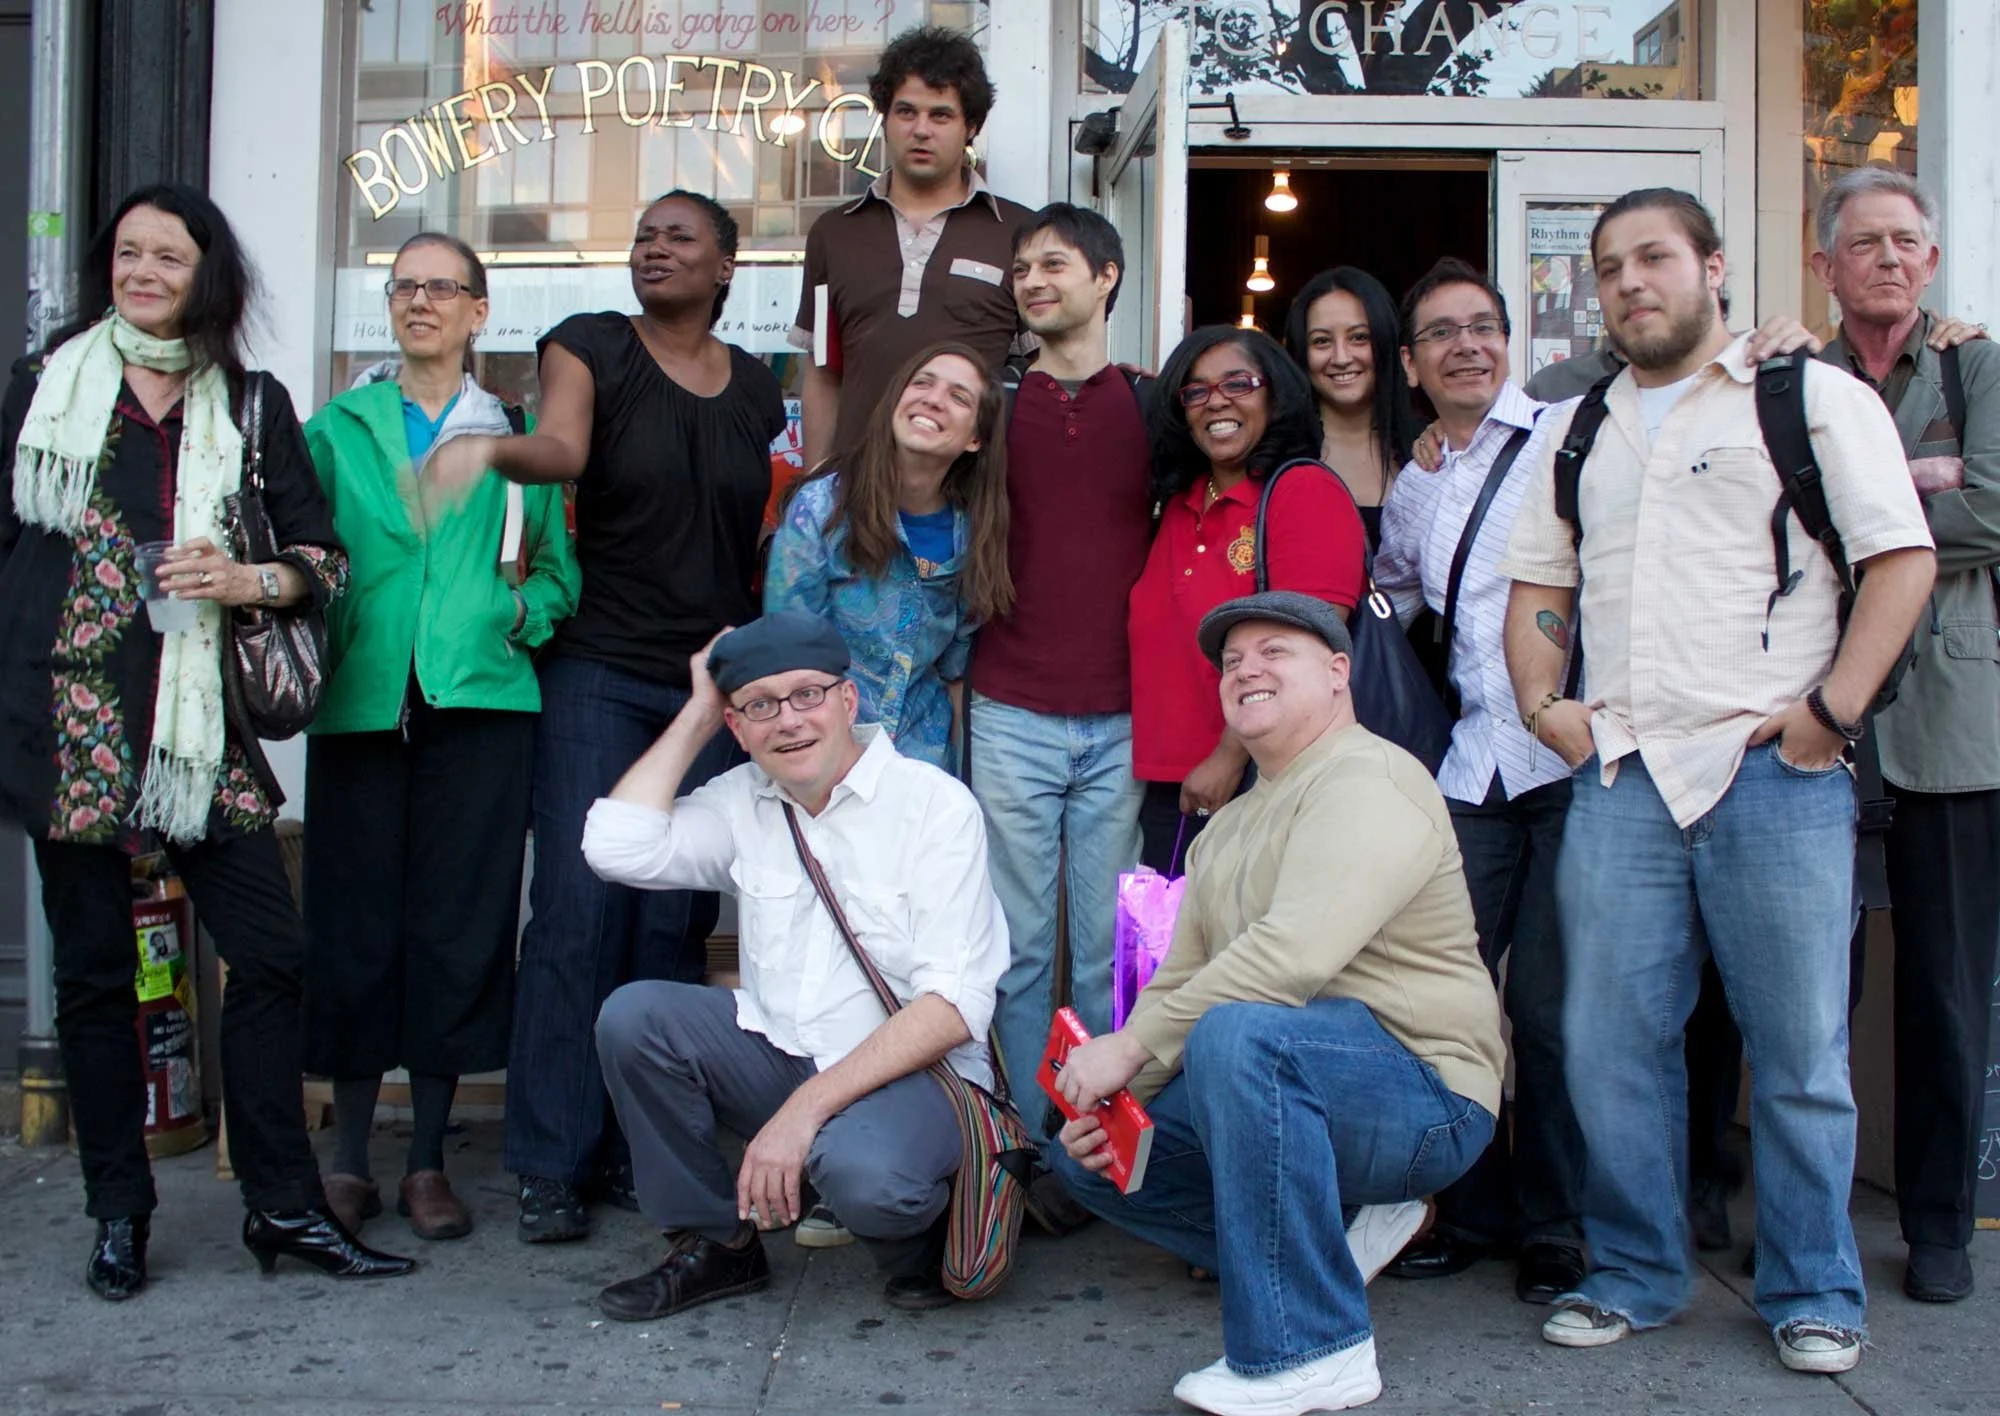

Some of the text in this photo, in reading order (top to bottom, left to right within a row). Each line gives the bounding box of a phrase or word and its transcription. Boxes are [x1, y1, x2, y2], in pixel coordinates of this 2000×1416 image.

[435, 0, 519, 36] What
[521, 3, 570, 35] the
[579, 0, 642, 34] hell
[643, 5, 671, 34] is
[671, 5, 757, 49] going
[762, 12, 801, 33] on
[803, 0, 864, 35] here
[1307, 0, 1614, 61] CHANGE
[342, 66, 557, 222] BOWERY
[574, 54, 823, 148] POETRY
[1531, 227, 1580, 242] Rhythm
